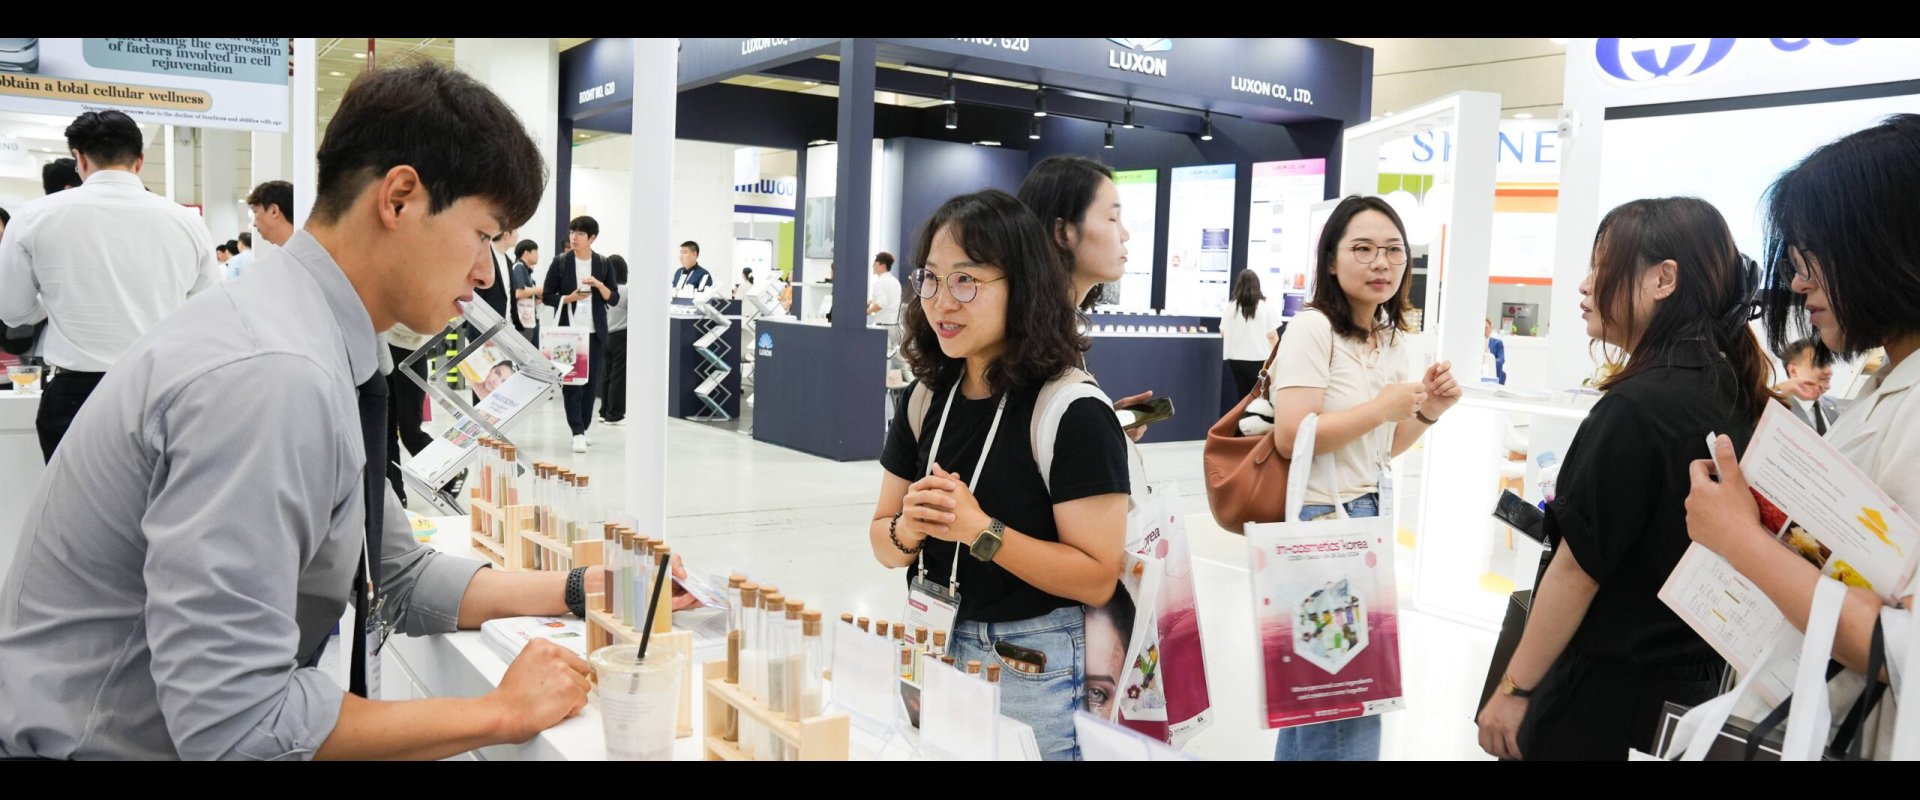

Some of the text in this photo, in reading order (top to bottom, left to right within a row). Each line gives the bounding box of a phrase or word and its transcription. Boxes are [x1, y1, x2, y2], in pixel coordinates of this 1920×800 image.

[108, 41, 271, 66] of factors involved in cell
[191, 38, 211, 49] the
[215, 41, 281, 56] expression
[1001, 38, 1029, 52] G20
[152, 58, 233, 74] rejuvenation
[1109, 49, 1167, 76] LUXON
[0, 75, 204, 105] btain a total cellular wellness
[1231, 76, 1314, 104] LUXON CO., LTD.
[1412, 130, 1558, 162] SNE
